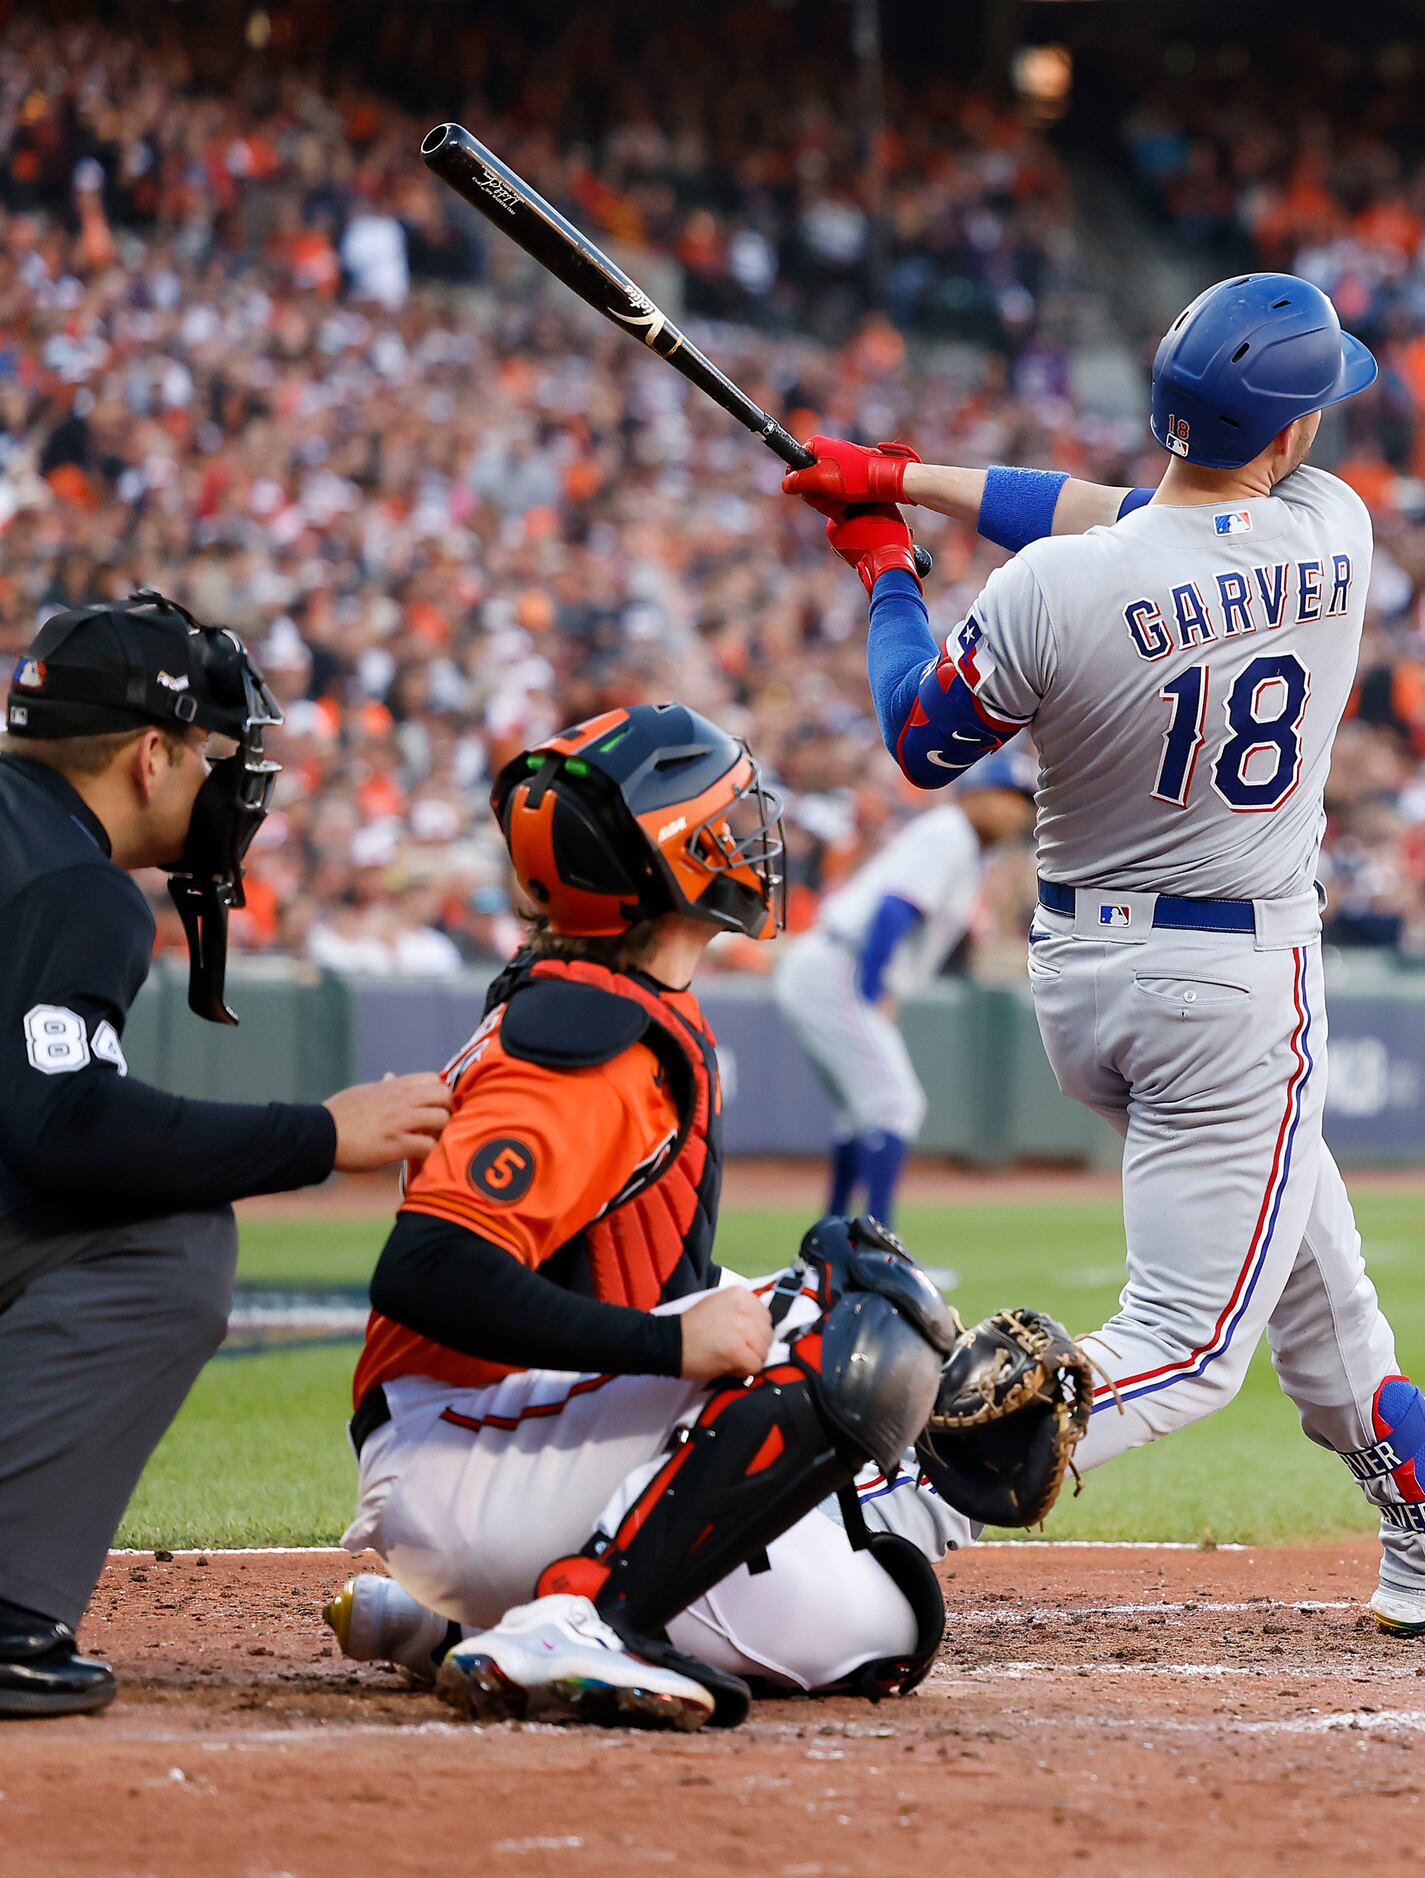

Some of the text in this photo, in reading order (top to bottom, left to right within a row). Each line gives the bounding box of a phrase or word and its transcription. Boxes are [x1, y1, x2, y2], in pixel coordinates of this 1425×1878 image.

[1169, 414, 1190, 440] 18
[1122, 552, 1353, 662] GARVER
[1150, 649, 1312, 813] 18
[484, 1147, 527, 1190] 5
